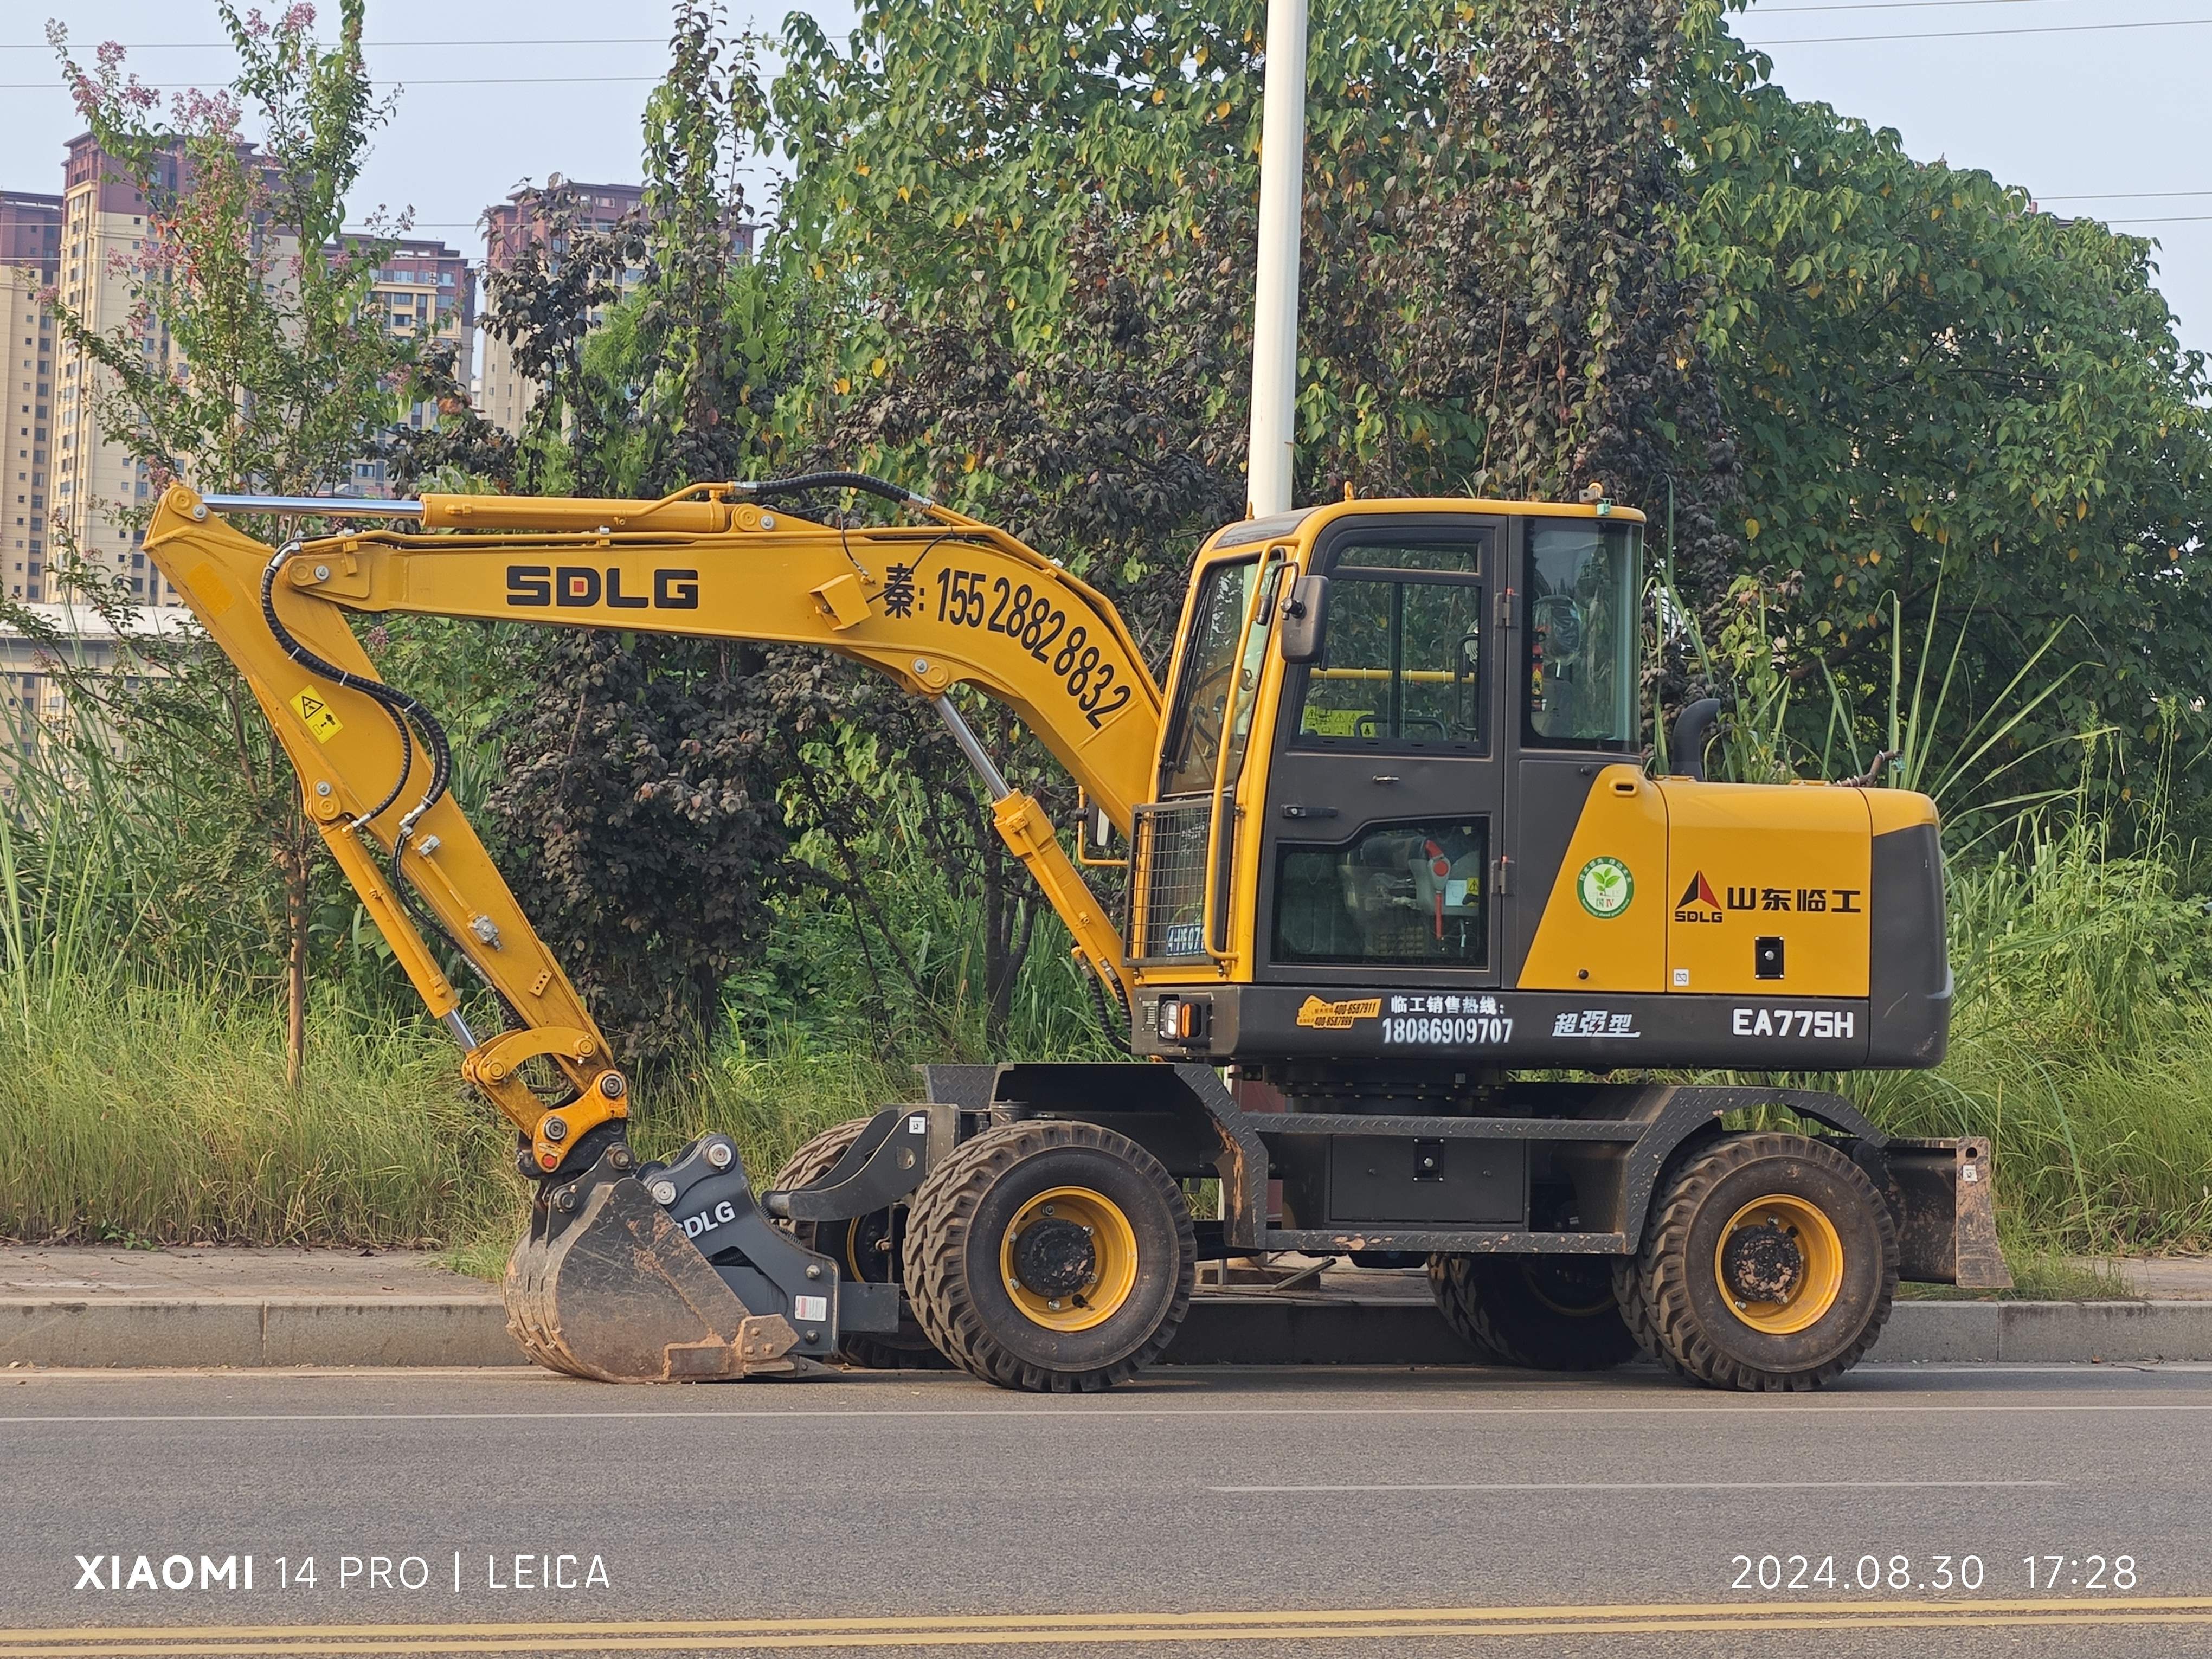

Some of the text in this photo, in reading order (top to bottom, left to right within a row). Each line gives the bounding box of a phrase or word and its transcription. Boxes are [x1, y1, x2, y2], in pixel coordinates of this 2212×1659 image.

[506, 565, 698, 609] SDLG
[1727, 887, 1861, 912] 山东临工
[1674, 911, 1722, 923] SDLG
[1391, 995, 1504, 1015] 临工销售热线：
[1382, 1017, 1513, 1044] 18086909707
[1552, 1010, 1641, 1038] 超强型
[677, 1200, 736, 1239] DLG
